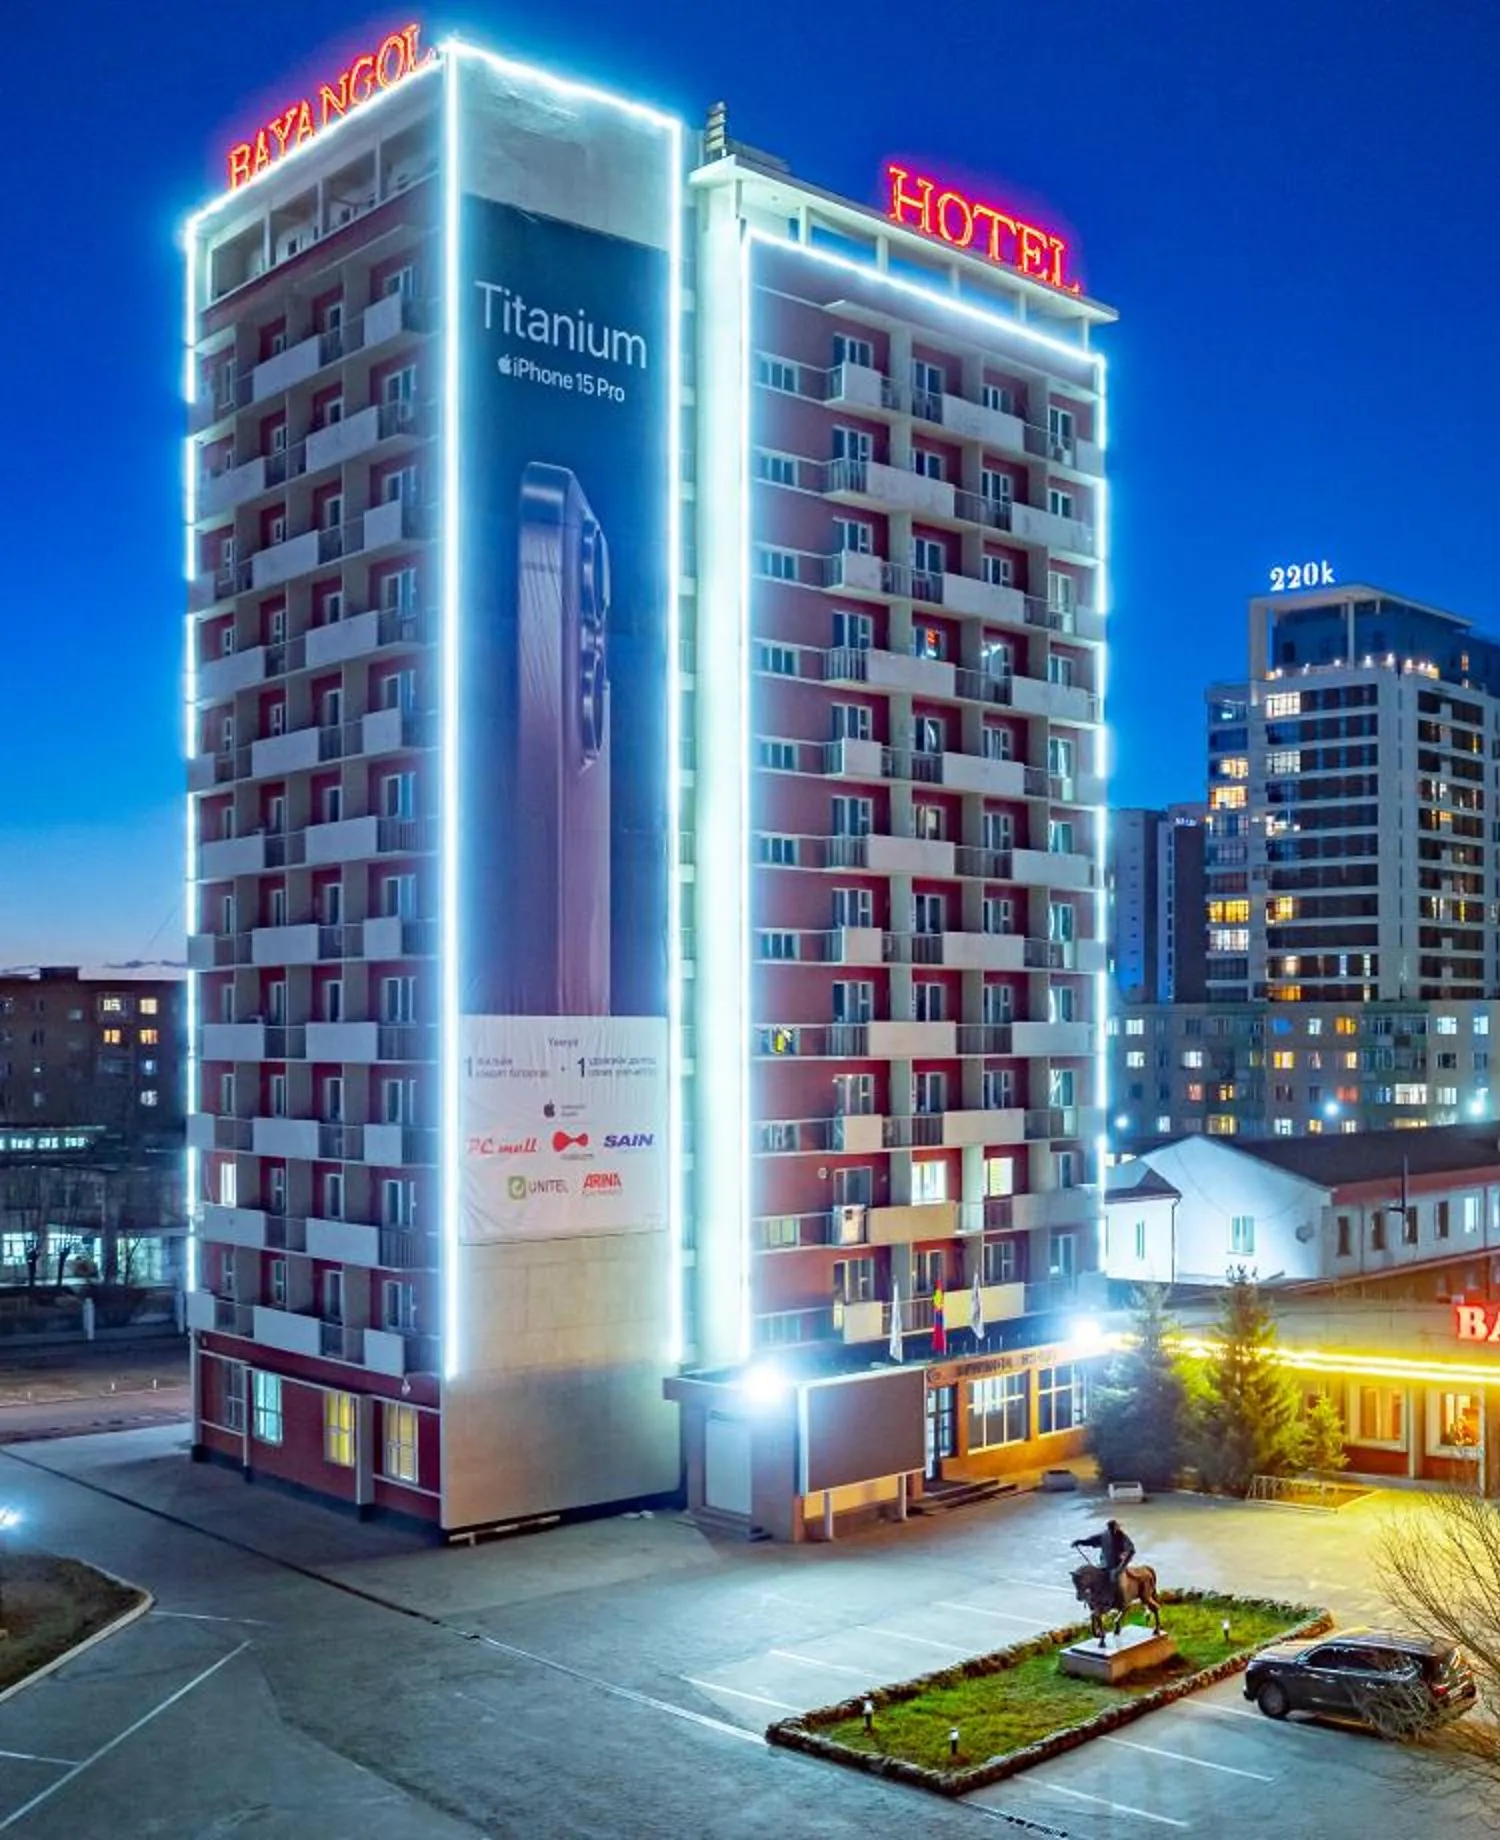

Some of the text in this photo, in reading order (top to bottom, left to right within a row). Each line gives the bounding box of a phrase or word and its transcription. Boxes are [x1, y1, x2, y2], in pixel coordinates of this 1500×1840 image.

[227, 23, 436, 191] BAYANGOL
[888, 165, 1081, 296] HOTEL
[474, 280, 647, 369] Titanium
[513, 357, 625, 402] iPhone 15 Pro
[1270, 560, 1335, 591] 220k
[603, 1133, 655, 1148] SAIN
[528, 1178, 569, 1194] UNITEL
